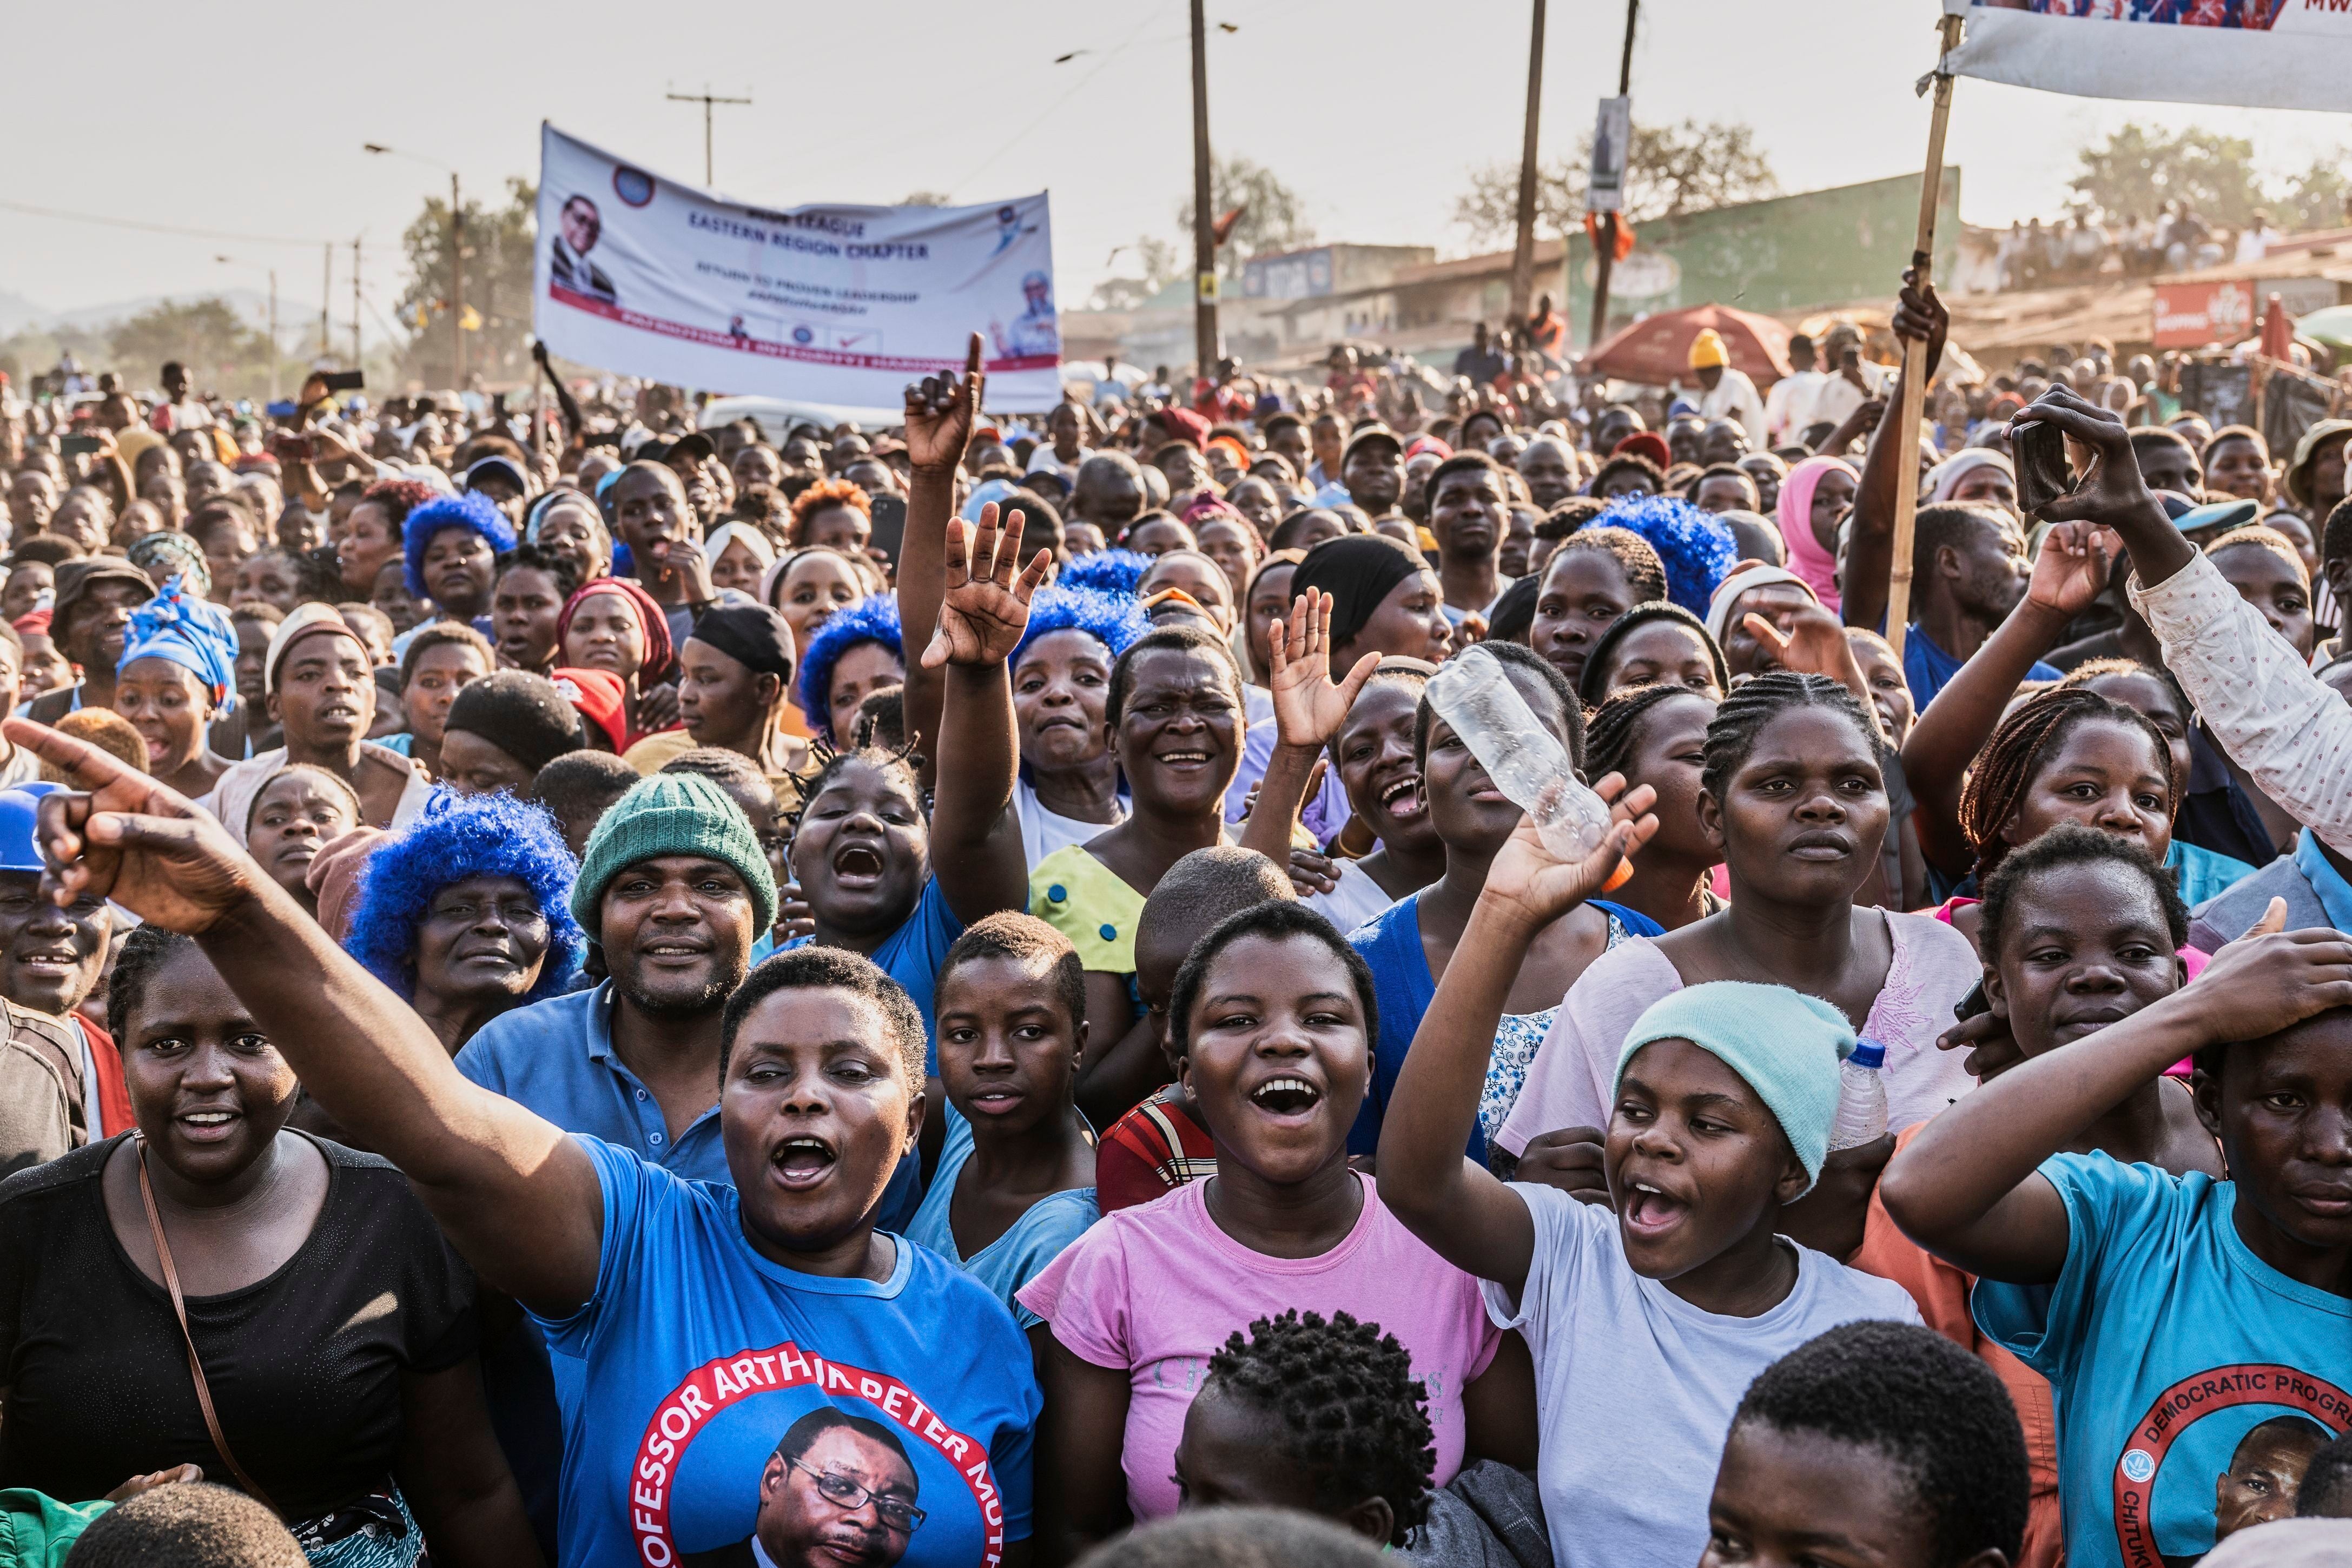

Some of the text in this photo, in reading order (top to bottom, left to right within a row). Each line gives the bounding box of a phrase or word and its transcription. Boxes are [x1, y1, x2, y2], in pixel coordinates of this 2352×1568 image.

[689, 212, 765, 243] EASTERN
[772, 231, 840, 257] REGION
[846, 243, 929, 260] CHAPTER
[696, 260, 750, 282] RETURN
[776, 275, 832, 296] PROVEN
[835, 287, 919, 303] LEADERSHIP
[756, 341, 857, 366] INTEGRITY
[2144, 1373, 2267, 1444] DEMOCRATIC
[635, 1384, 713, 1568] OFESSOR
[849, 1377, 969, 1462] PETER
